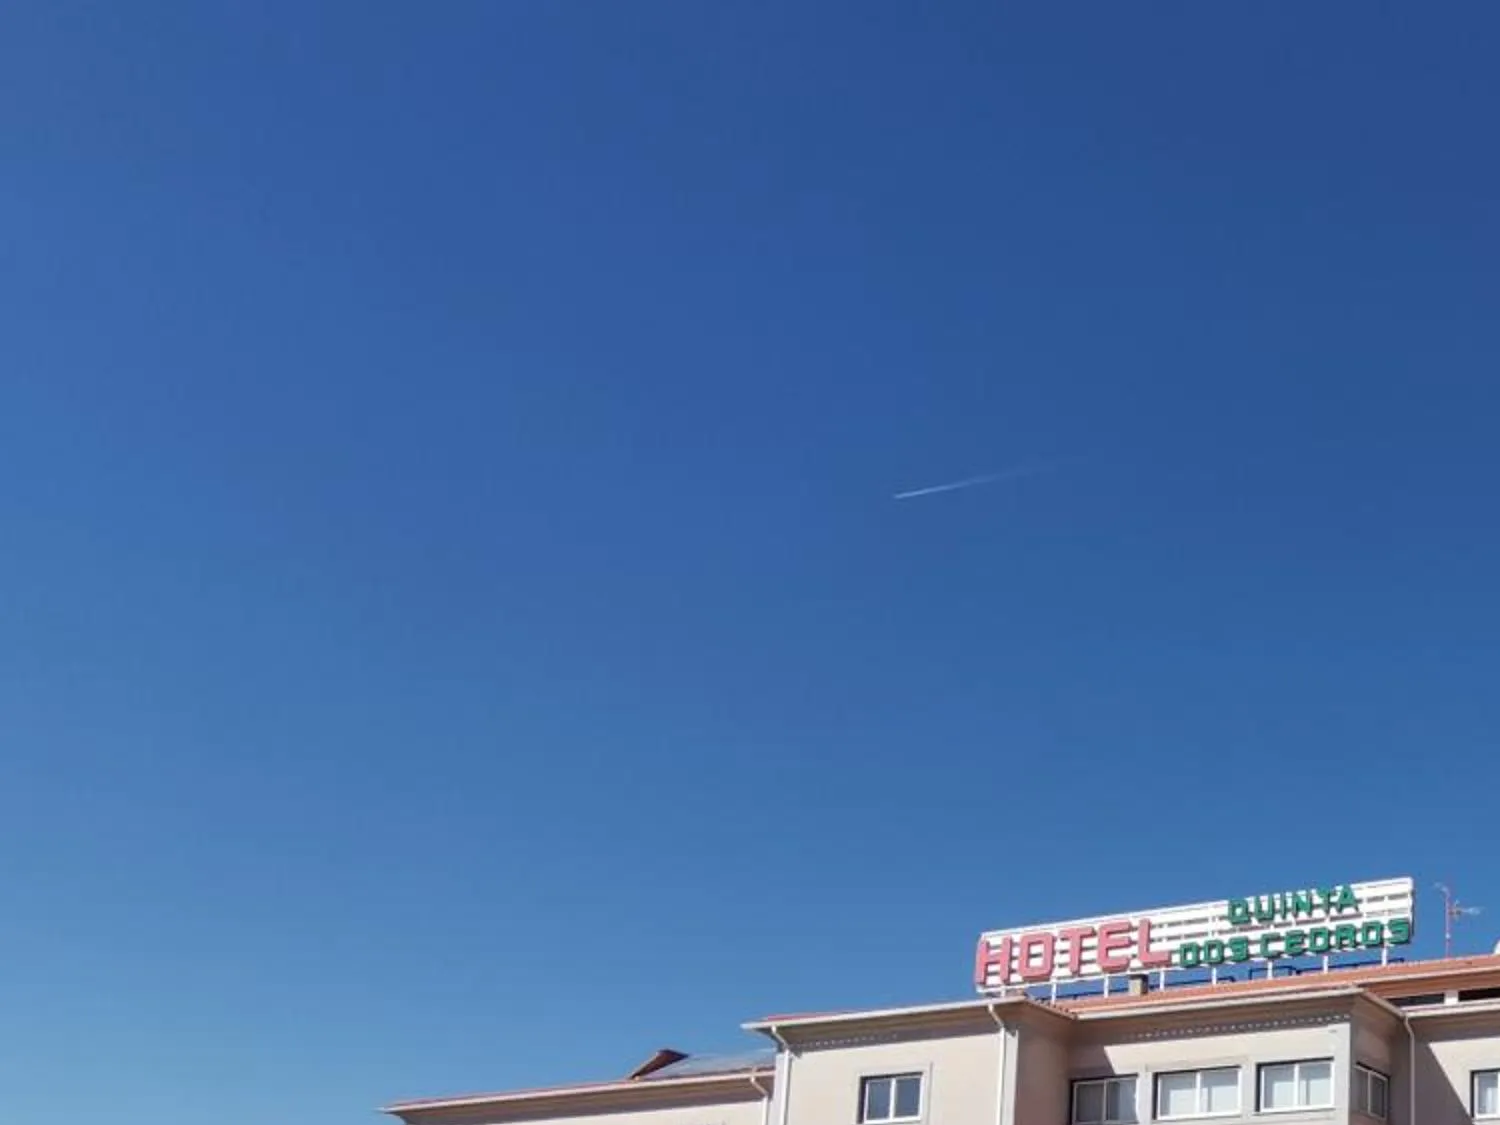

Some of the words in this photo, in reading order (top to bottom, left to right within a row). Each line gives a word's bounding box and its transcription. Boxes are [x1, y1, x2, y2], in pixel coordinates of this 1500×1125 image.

[1229, 884, 1359, 925] QUINTA
[975, 918, 1172, 983] HOTEL
[1179, 935, 1249, 967] DOS
[1259, 918, 1411, 958] CEDROS
